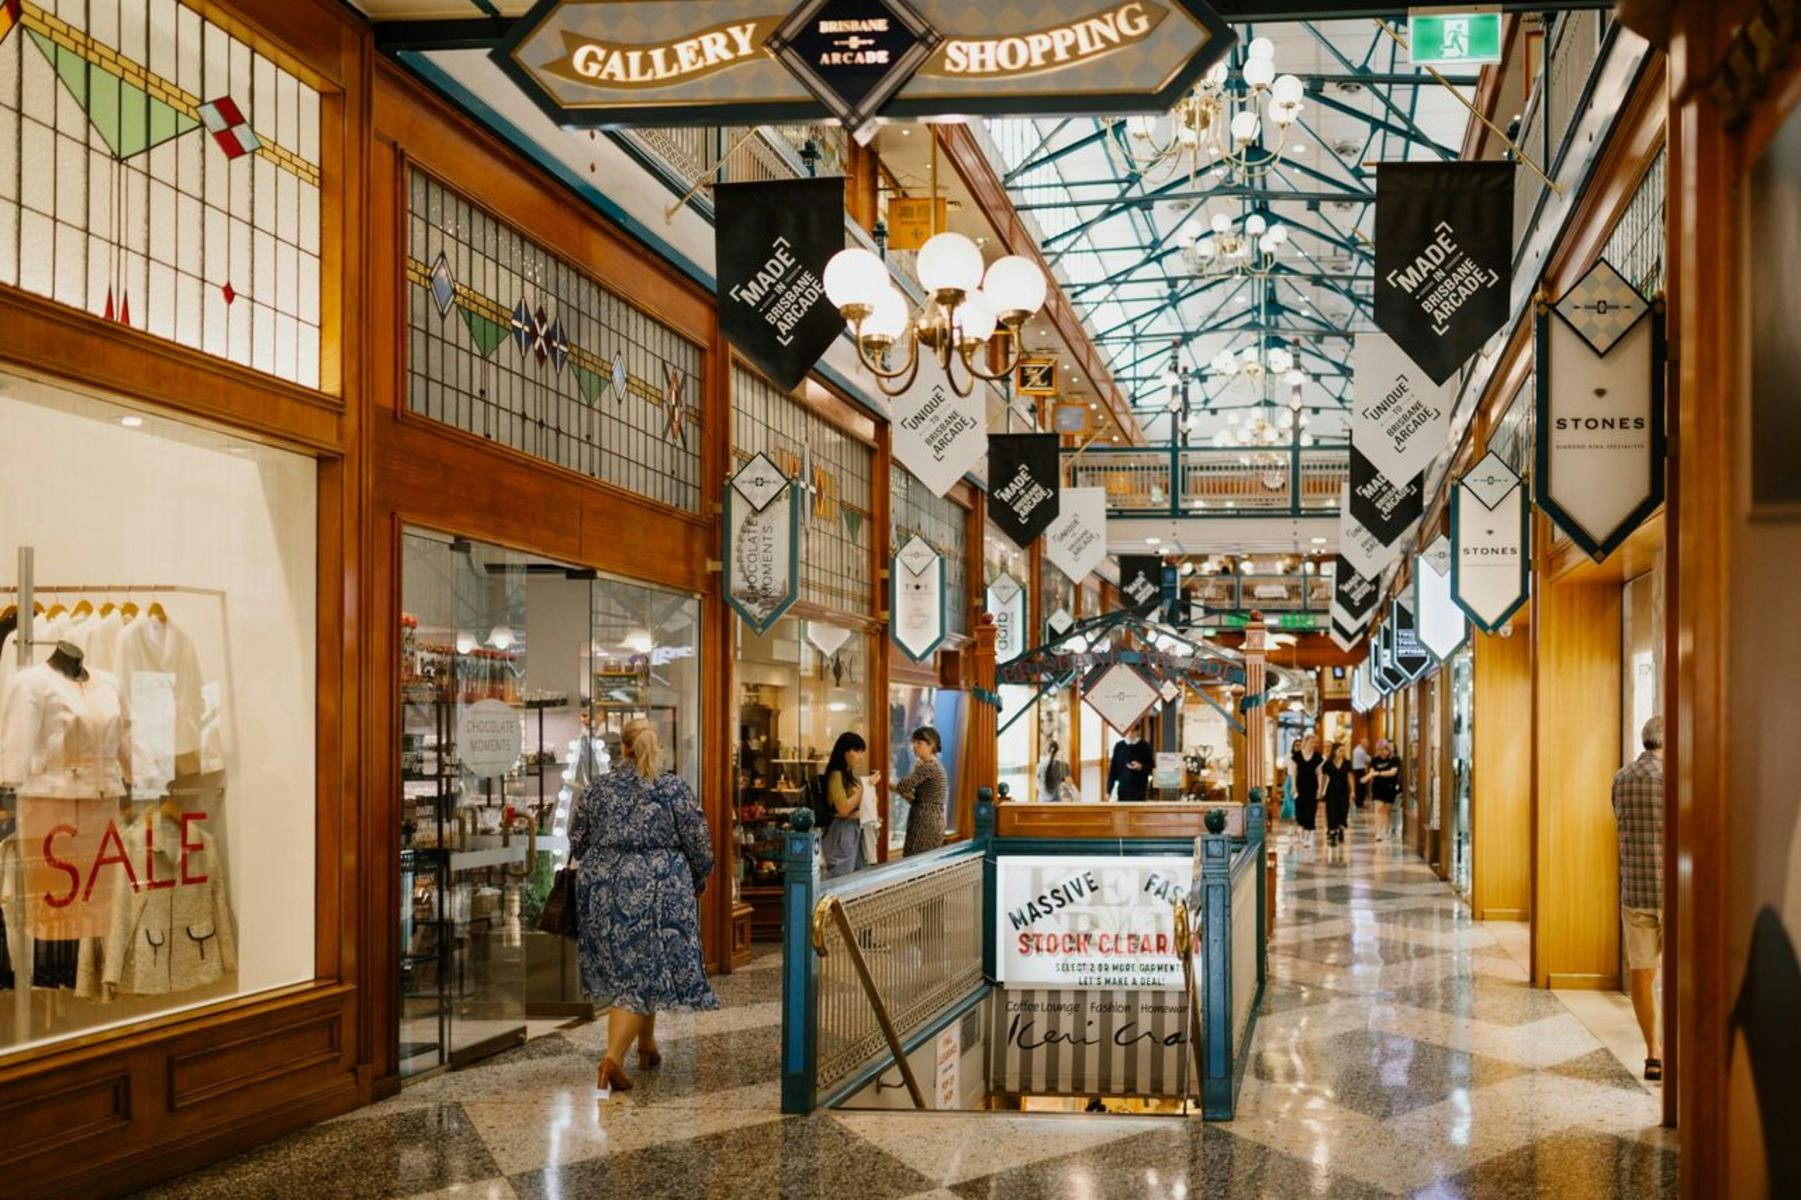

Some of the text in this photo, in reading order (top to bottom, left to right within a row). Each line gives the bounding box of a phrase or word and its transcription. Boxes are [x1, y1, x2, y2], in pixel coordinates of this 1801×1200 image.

[819, 19, 889, 33] BRISBANE
[944, 3, 1149, 73] SHOPPING
[572, 23, 757, 82] GALLERY
[820, 51, 890, 65] ARCADE
[739, 247, 796, 307] MADE
[1396, 232, 1457, 294] MADE
[1432, 268, 1446, 282] IN
[764, 270, 816, 325] BRISBANE
[773, 281, 787, 295] IN
[1421, 257, 1476, 313] BRISBANE
[1432, 267, 1488, 325] ARCADE
[776, 279, 824, 335] ARCADE
[907, 391, 945, 430] UNIQUE
[1369, 382, 1410, 420] UNIQUE
[1386, 399, 1424, 437] BRISBANE
[1392, 404, 1403, 415] TO
[924, 409, 960, 446] BRISBANE
[933, 416, 970, 455] ARCADE
[1394, 406, 1433, 446] ARCADE
[1556, 417, 1645, 430] STONES
[1000, 470, 1031, 502] MADE
[1019, 487, 1047, 518] ARCADE
[1362, 473, 1386, 499] MAD
[762, 525, 774, 599] MOMENTS
[1463, 547, 1518, 555] STONES
[466, 720, 515, 733] CHOCOLATE
[470, 739, 511, 752] MOMENTS
[43, 812, 208, 908] SALE
[1008, 871, 1099, 930] MASSIVE
[1018, 932, 1201, 955] STOCK CLEAR
[1055, 963, 1086, 973] SELECT
[1089, 963, 1095, 973] 2
[1097, 963, 1109, 973] OR
[1112, 963, 1135, 973] MORE
[1078, 976, 1102, 986] LET'S
[1104, 976, 1128, 986] MAKE
[1131, 976, 1138, 986] A
[1005, 1001, 1188, 1015] Coffee Lounge Fashion Homewar
[1114, 1021, 1189, 1046] Cra
